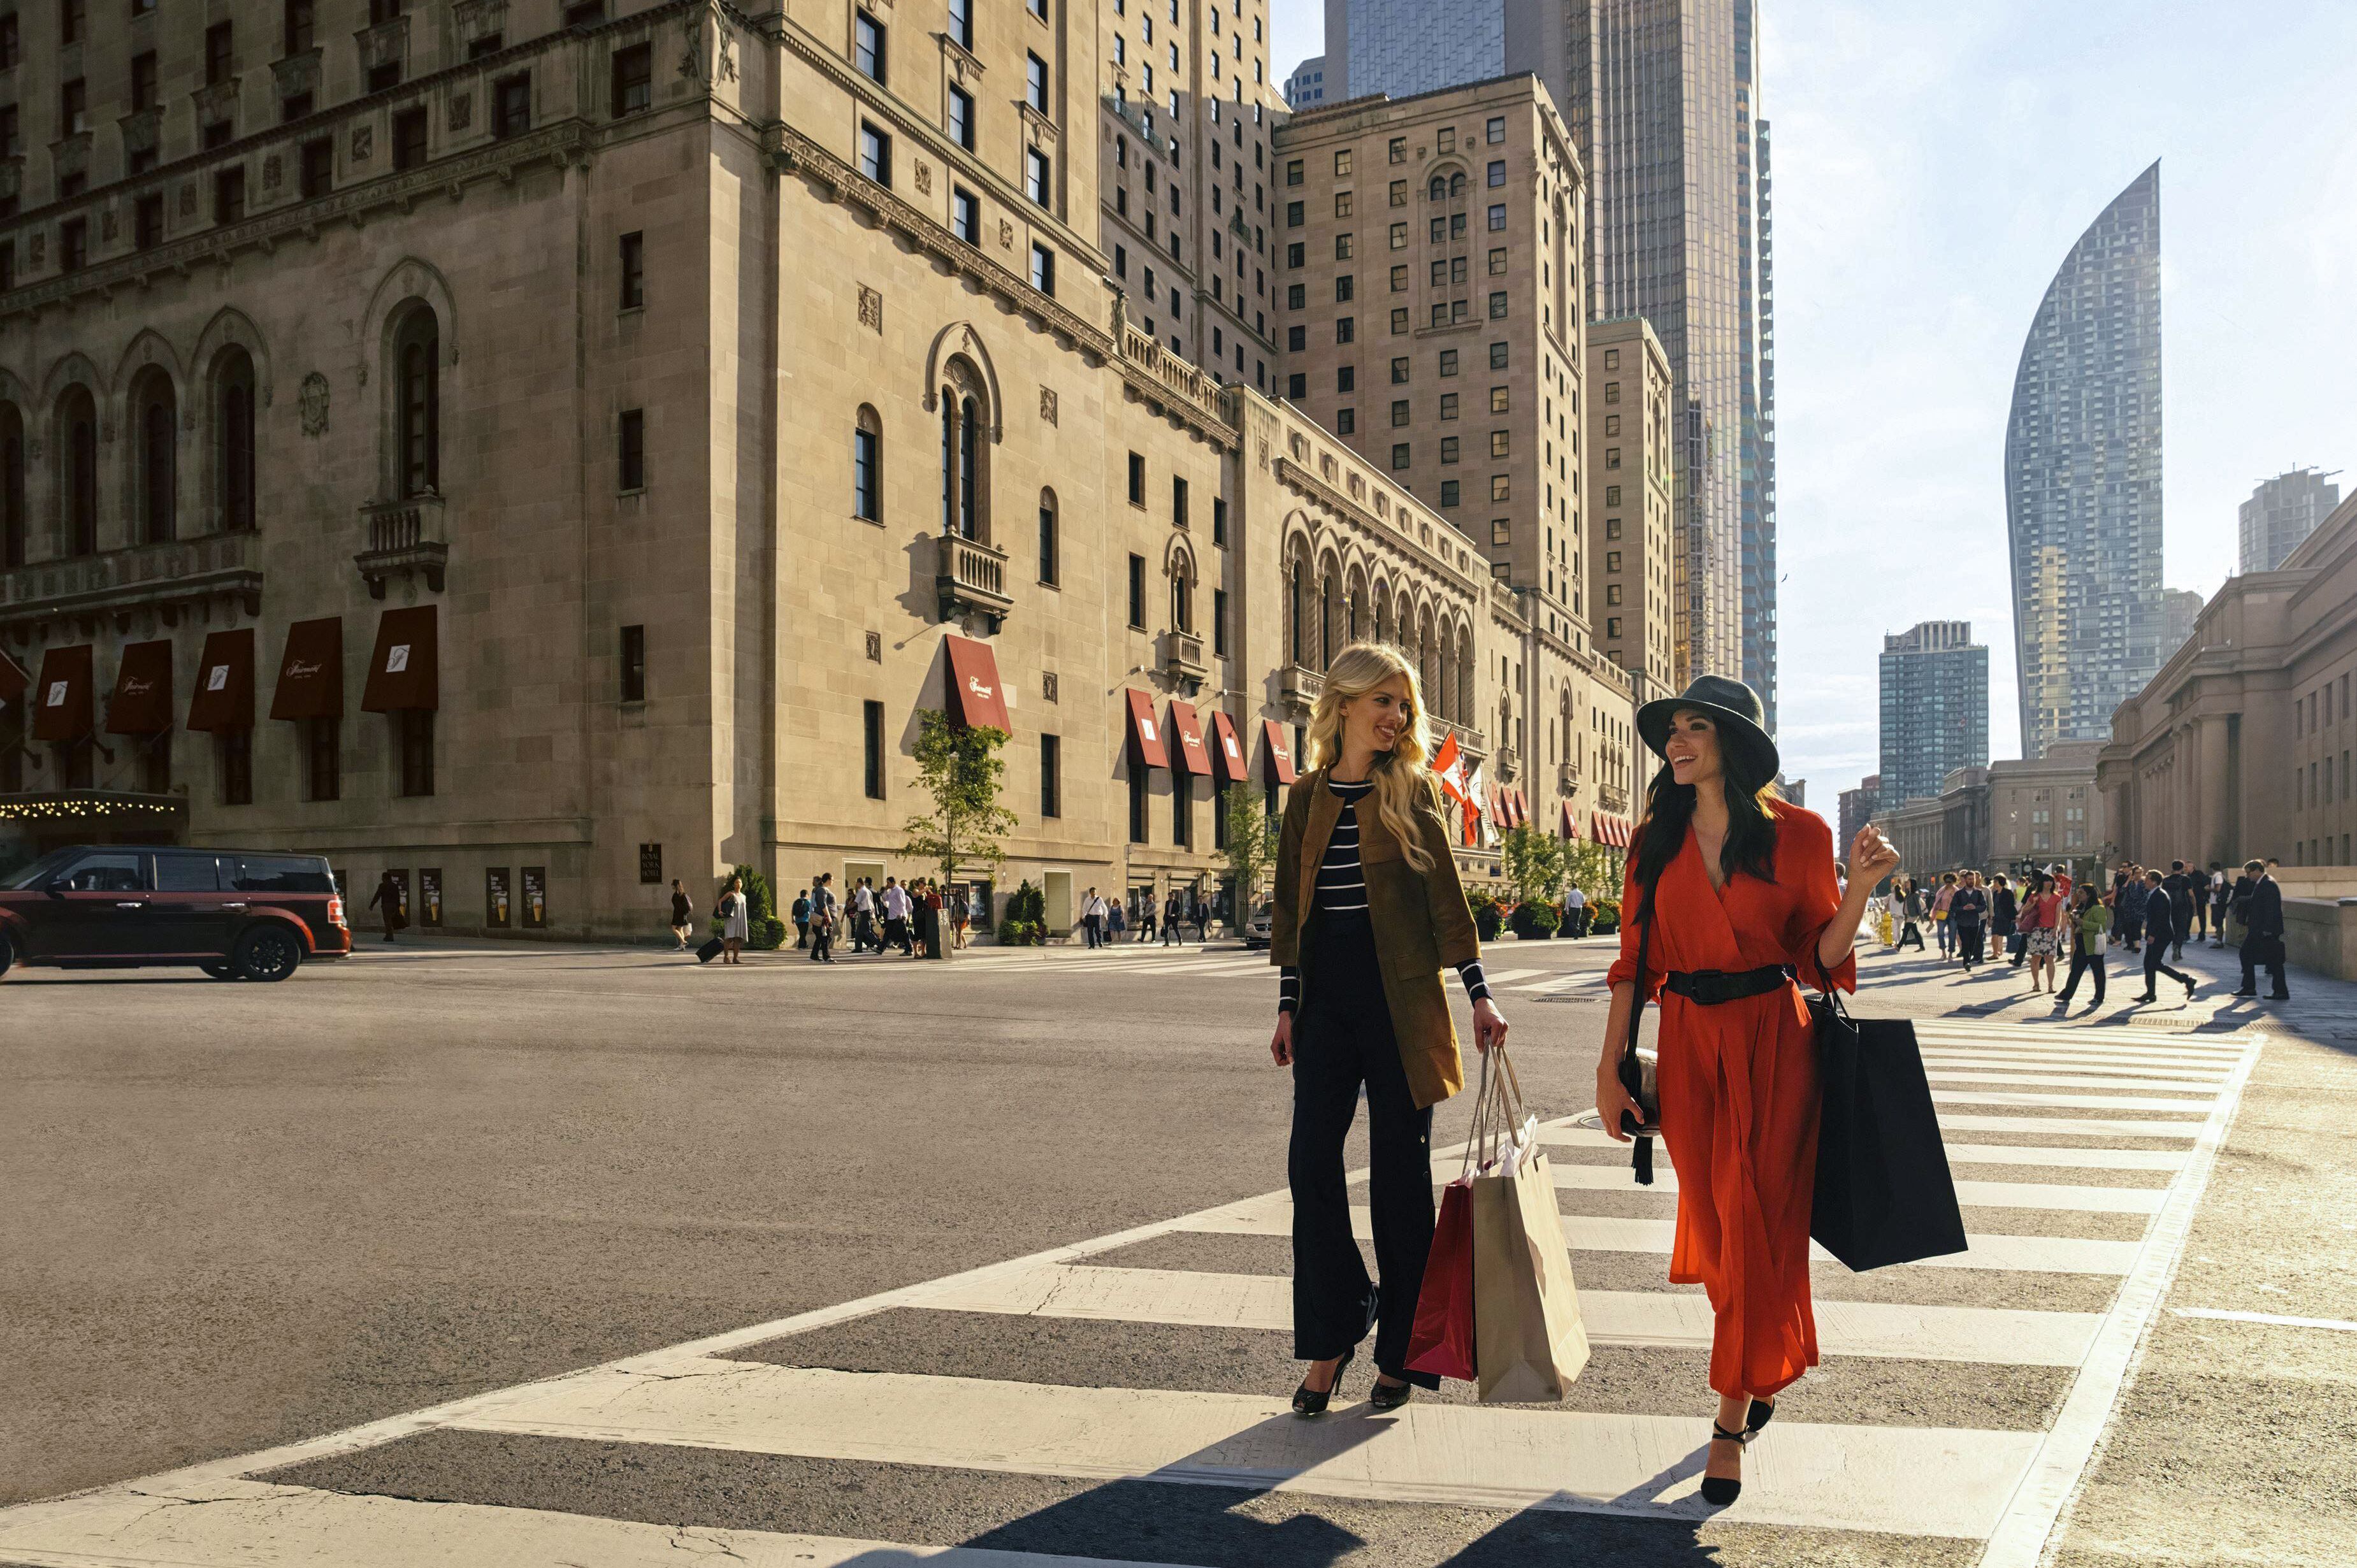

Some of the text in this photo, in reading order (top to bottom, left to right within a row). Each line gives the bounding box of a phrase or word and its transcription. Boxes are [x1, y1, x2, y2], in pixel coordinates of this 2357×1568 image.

[286, 659, 322, 677] Fairmont
[122, 675, 154, 694] Fairmont
[969, 676, 991, 696] Fairmont
